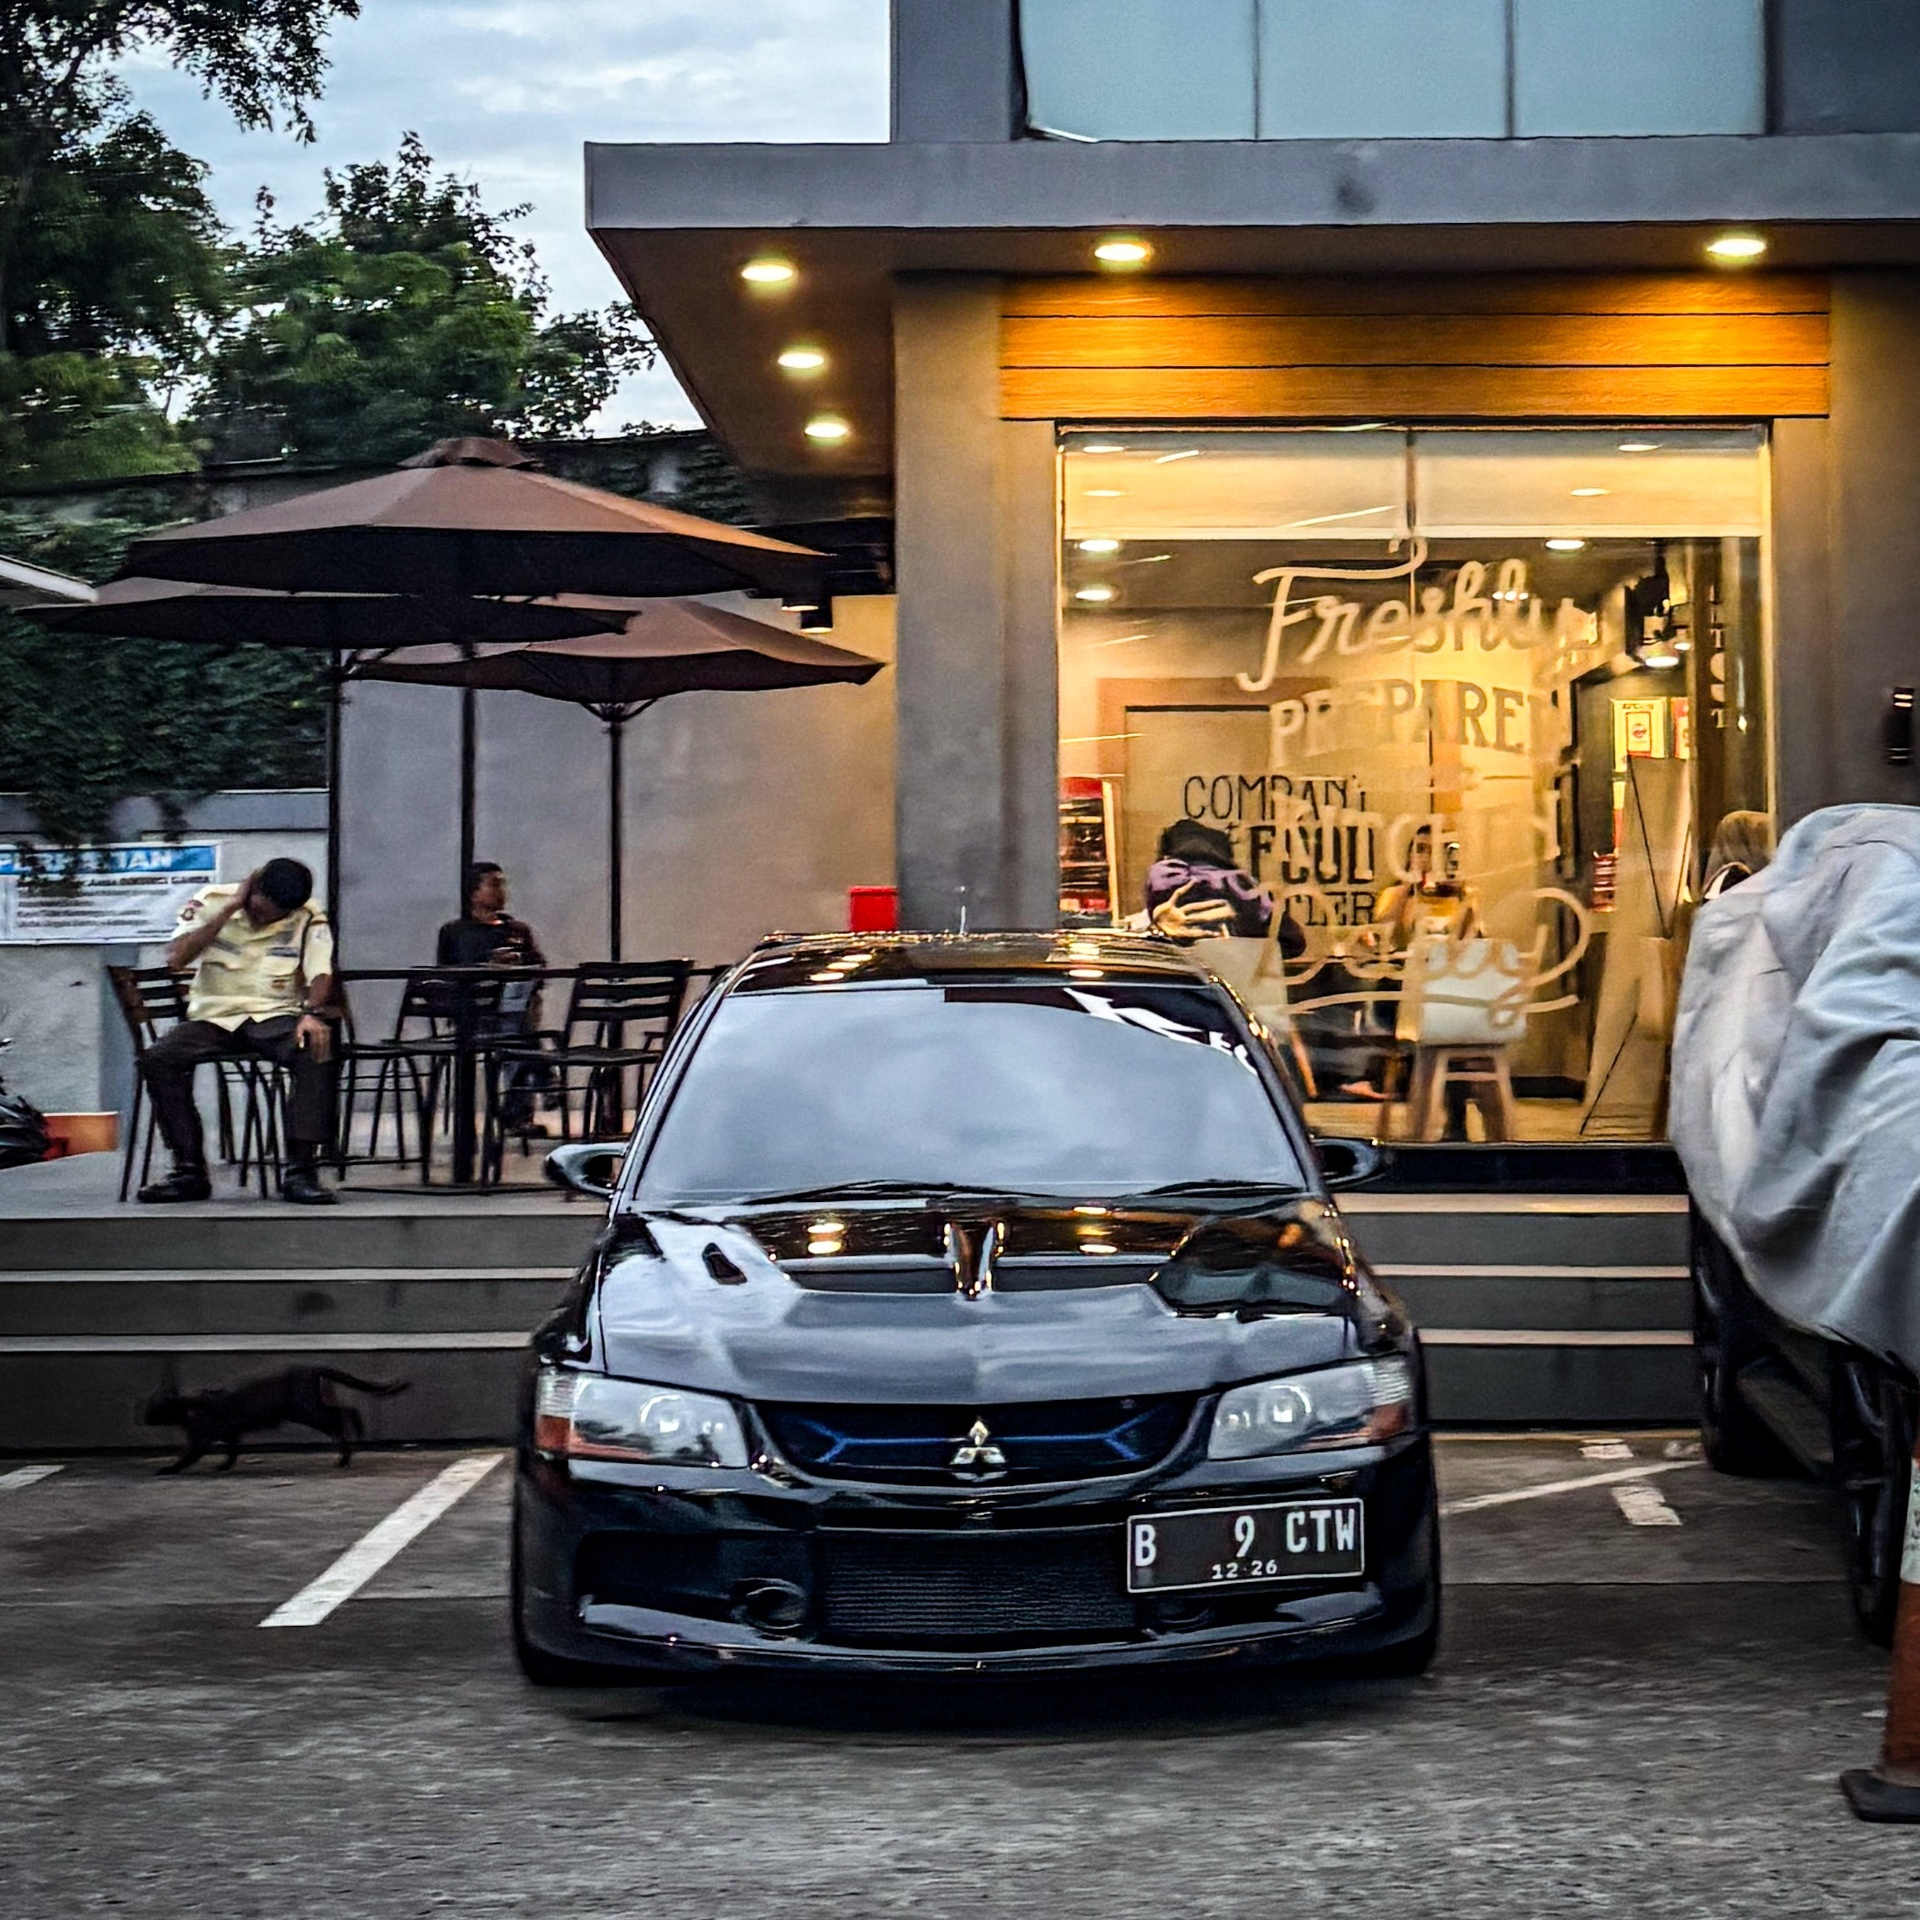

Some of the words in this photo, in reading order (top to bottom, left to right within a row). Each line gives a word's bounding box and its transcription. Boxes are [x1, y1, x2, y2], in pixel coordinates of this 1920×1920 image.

[1135, 1523, 1157, 1567] B
[1234, 1515, 1256, 1558] 9
[1286, 1508, 1356, 1553] CTW
